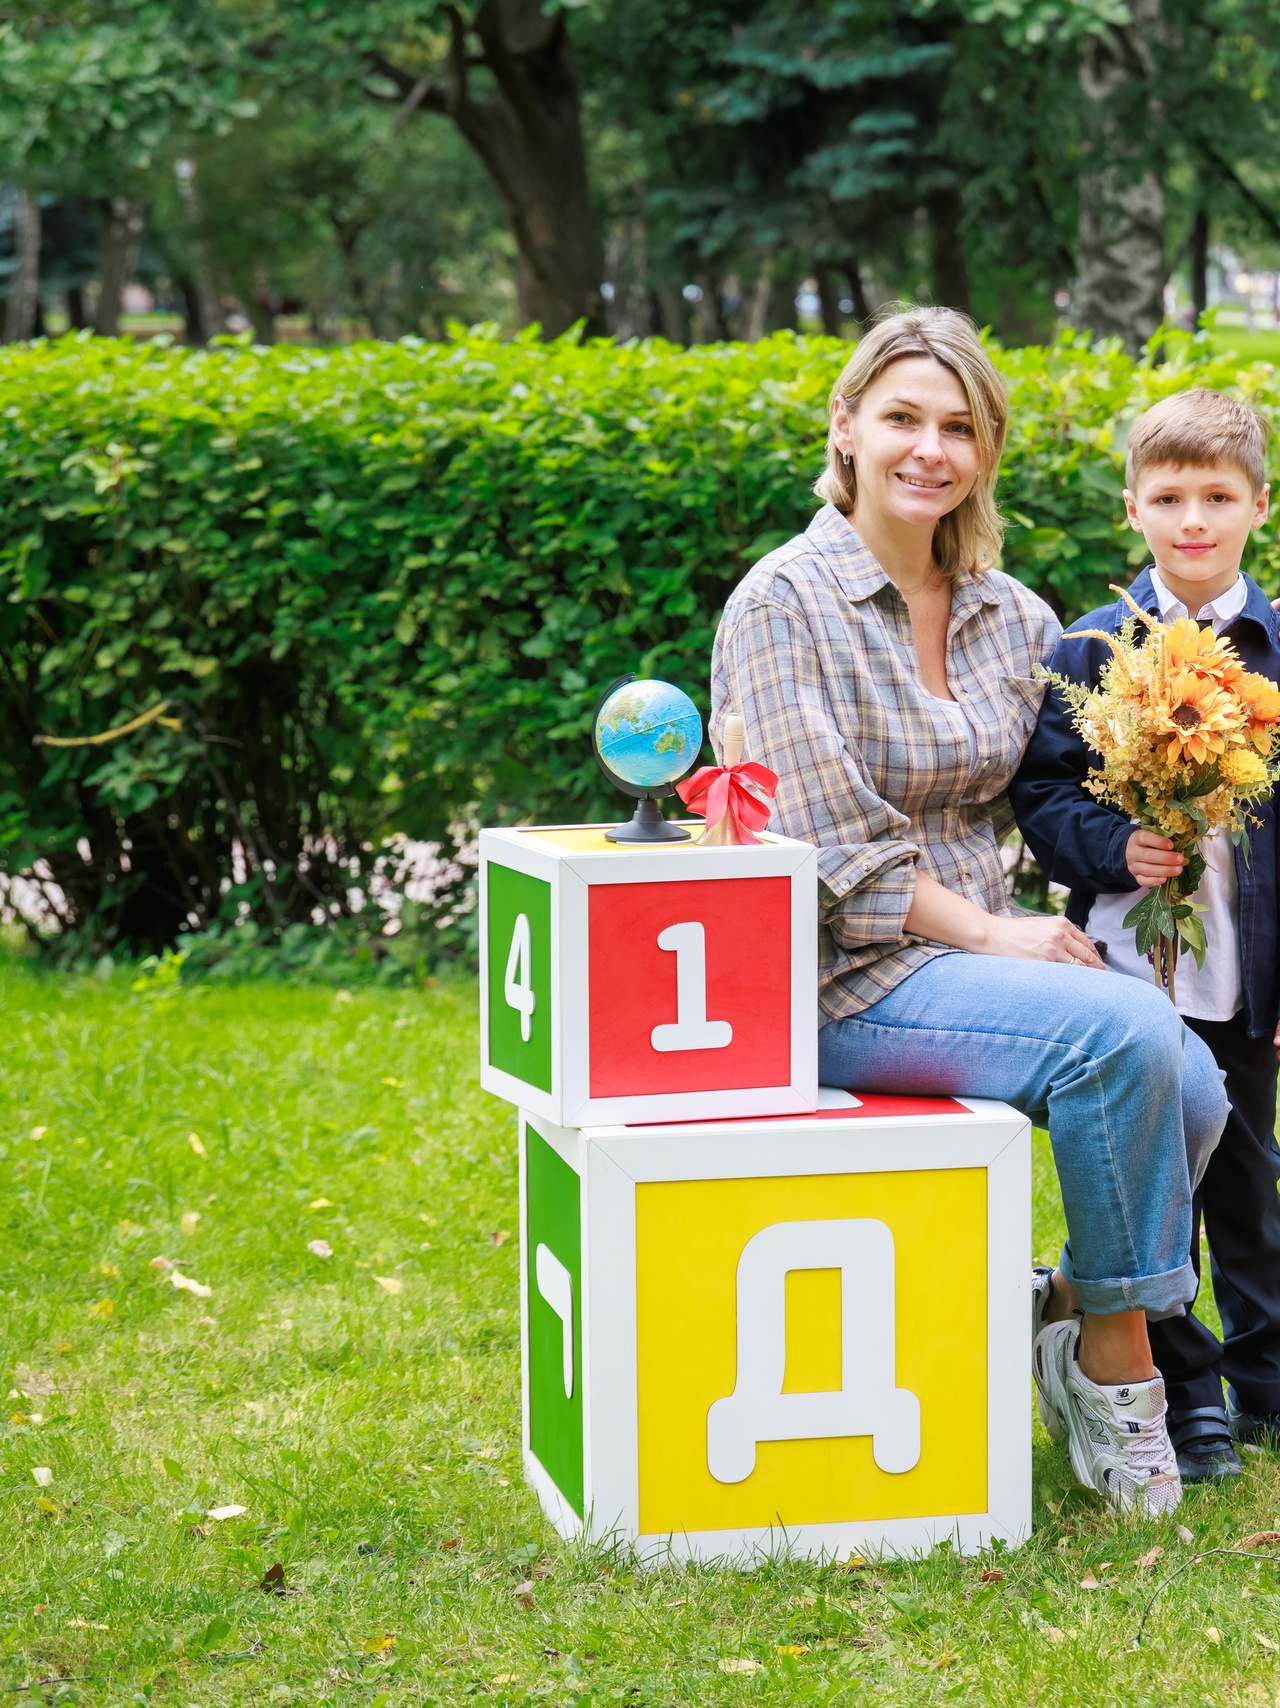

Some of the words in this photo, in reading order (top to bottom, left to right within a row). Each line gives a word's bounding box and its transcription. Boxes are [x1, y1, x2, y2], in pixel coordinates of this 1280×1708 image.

[504, 913, 535, 1042] 4
[650, 921, 733, 1052] 1
[706, 1217, 921, 1485] Д
